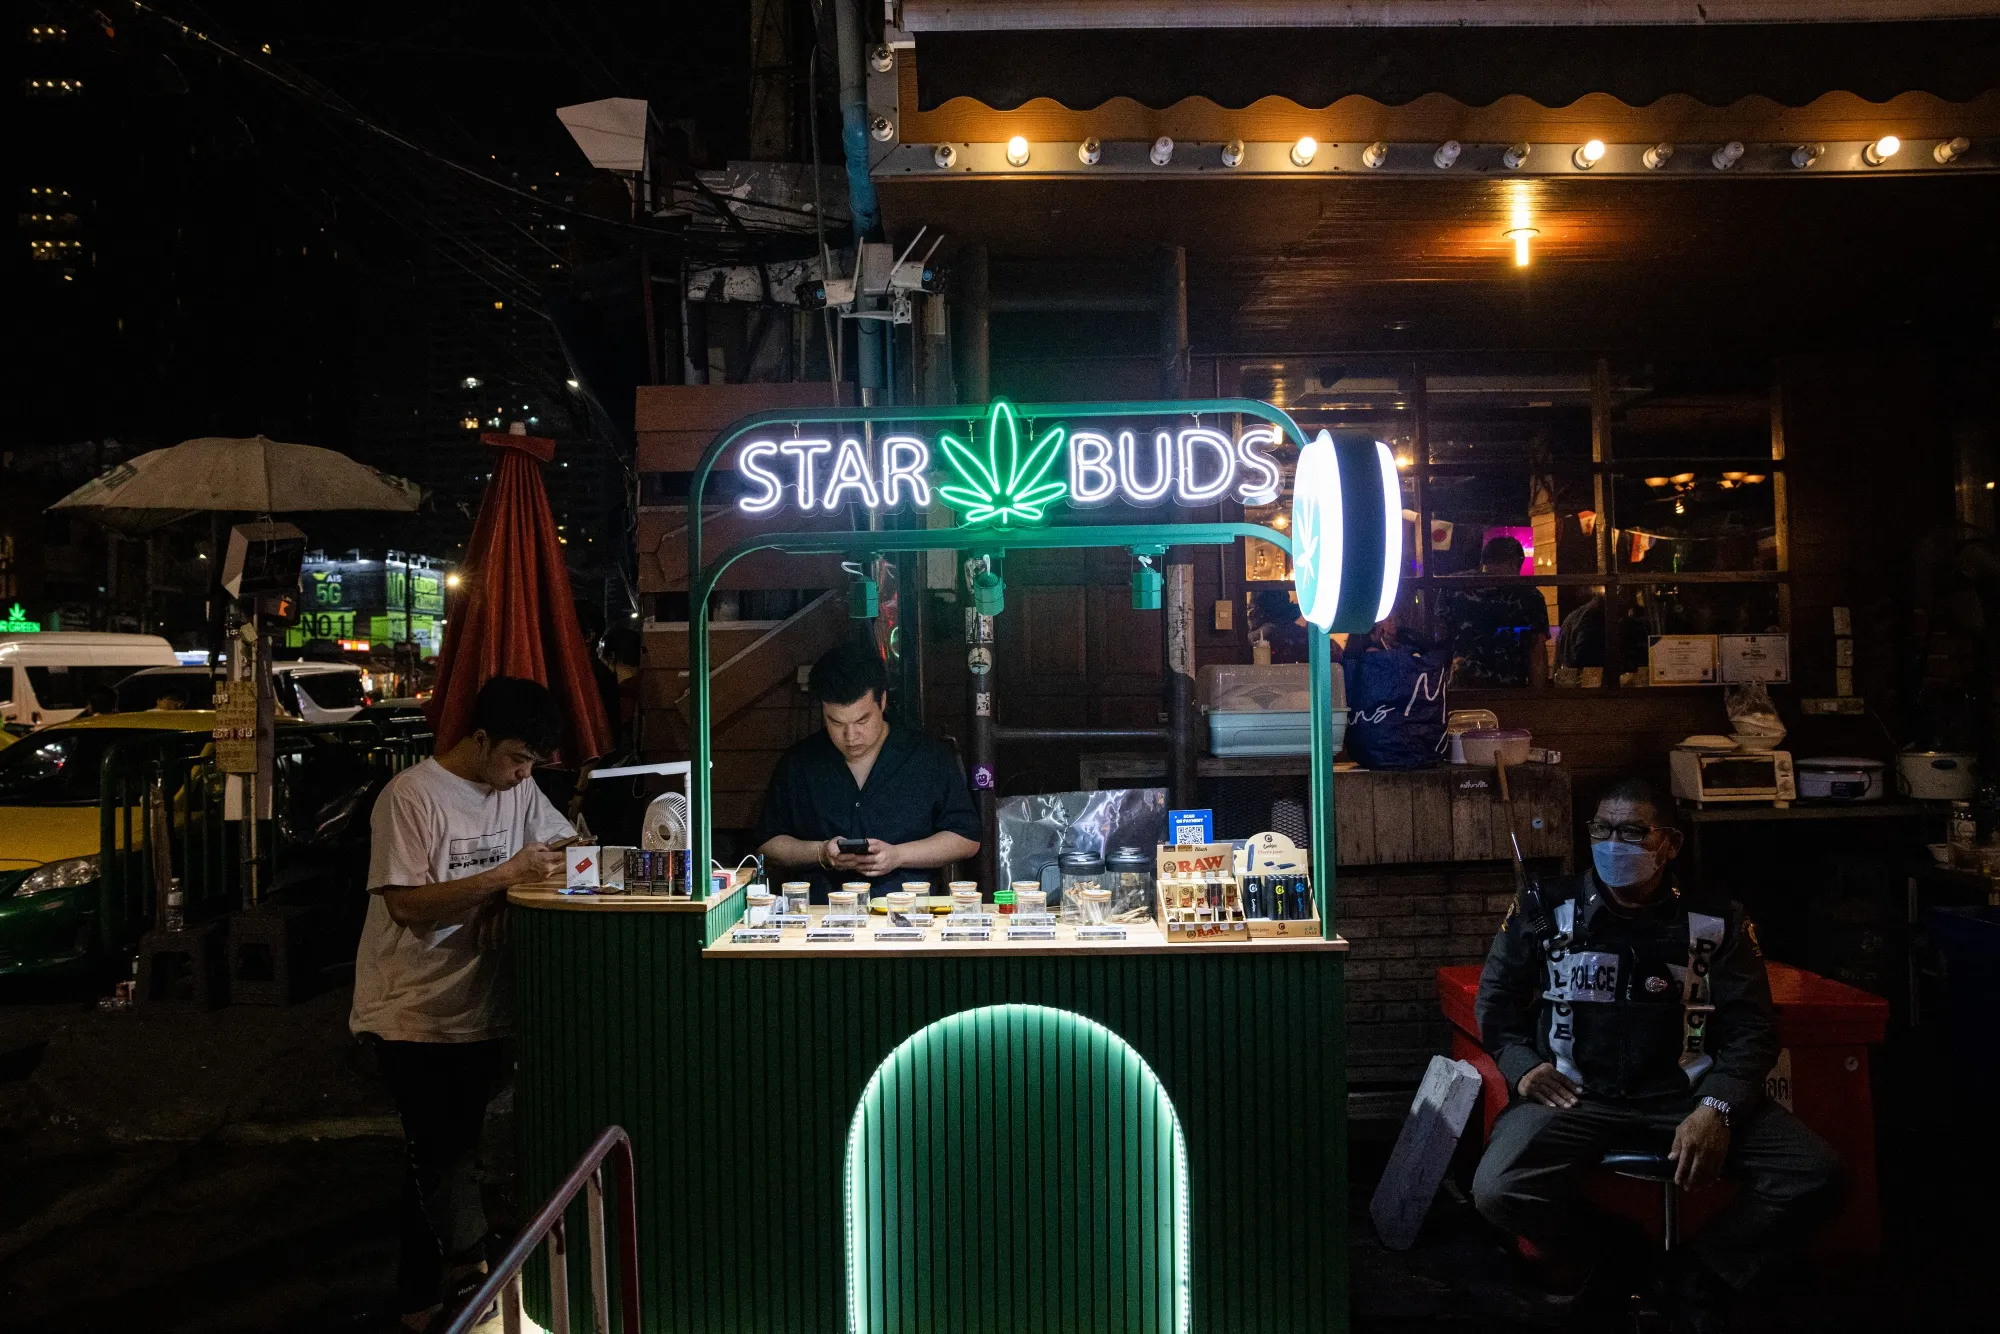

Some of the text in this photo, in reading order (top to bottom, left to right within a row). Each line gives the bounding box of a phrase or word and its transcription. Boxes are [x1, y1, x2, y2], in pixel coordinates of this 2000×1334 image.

[737, 425, 1282, 516] STAR BUDS
[326, 574, 343, 584] AIS
[316, 583, 343, 605] 5G
[8, 621, 41, 633] GREEN
[1178, 855, 1225, 872] RAW
[1687, 938, 1717, 1054] POLCE
